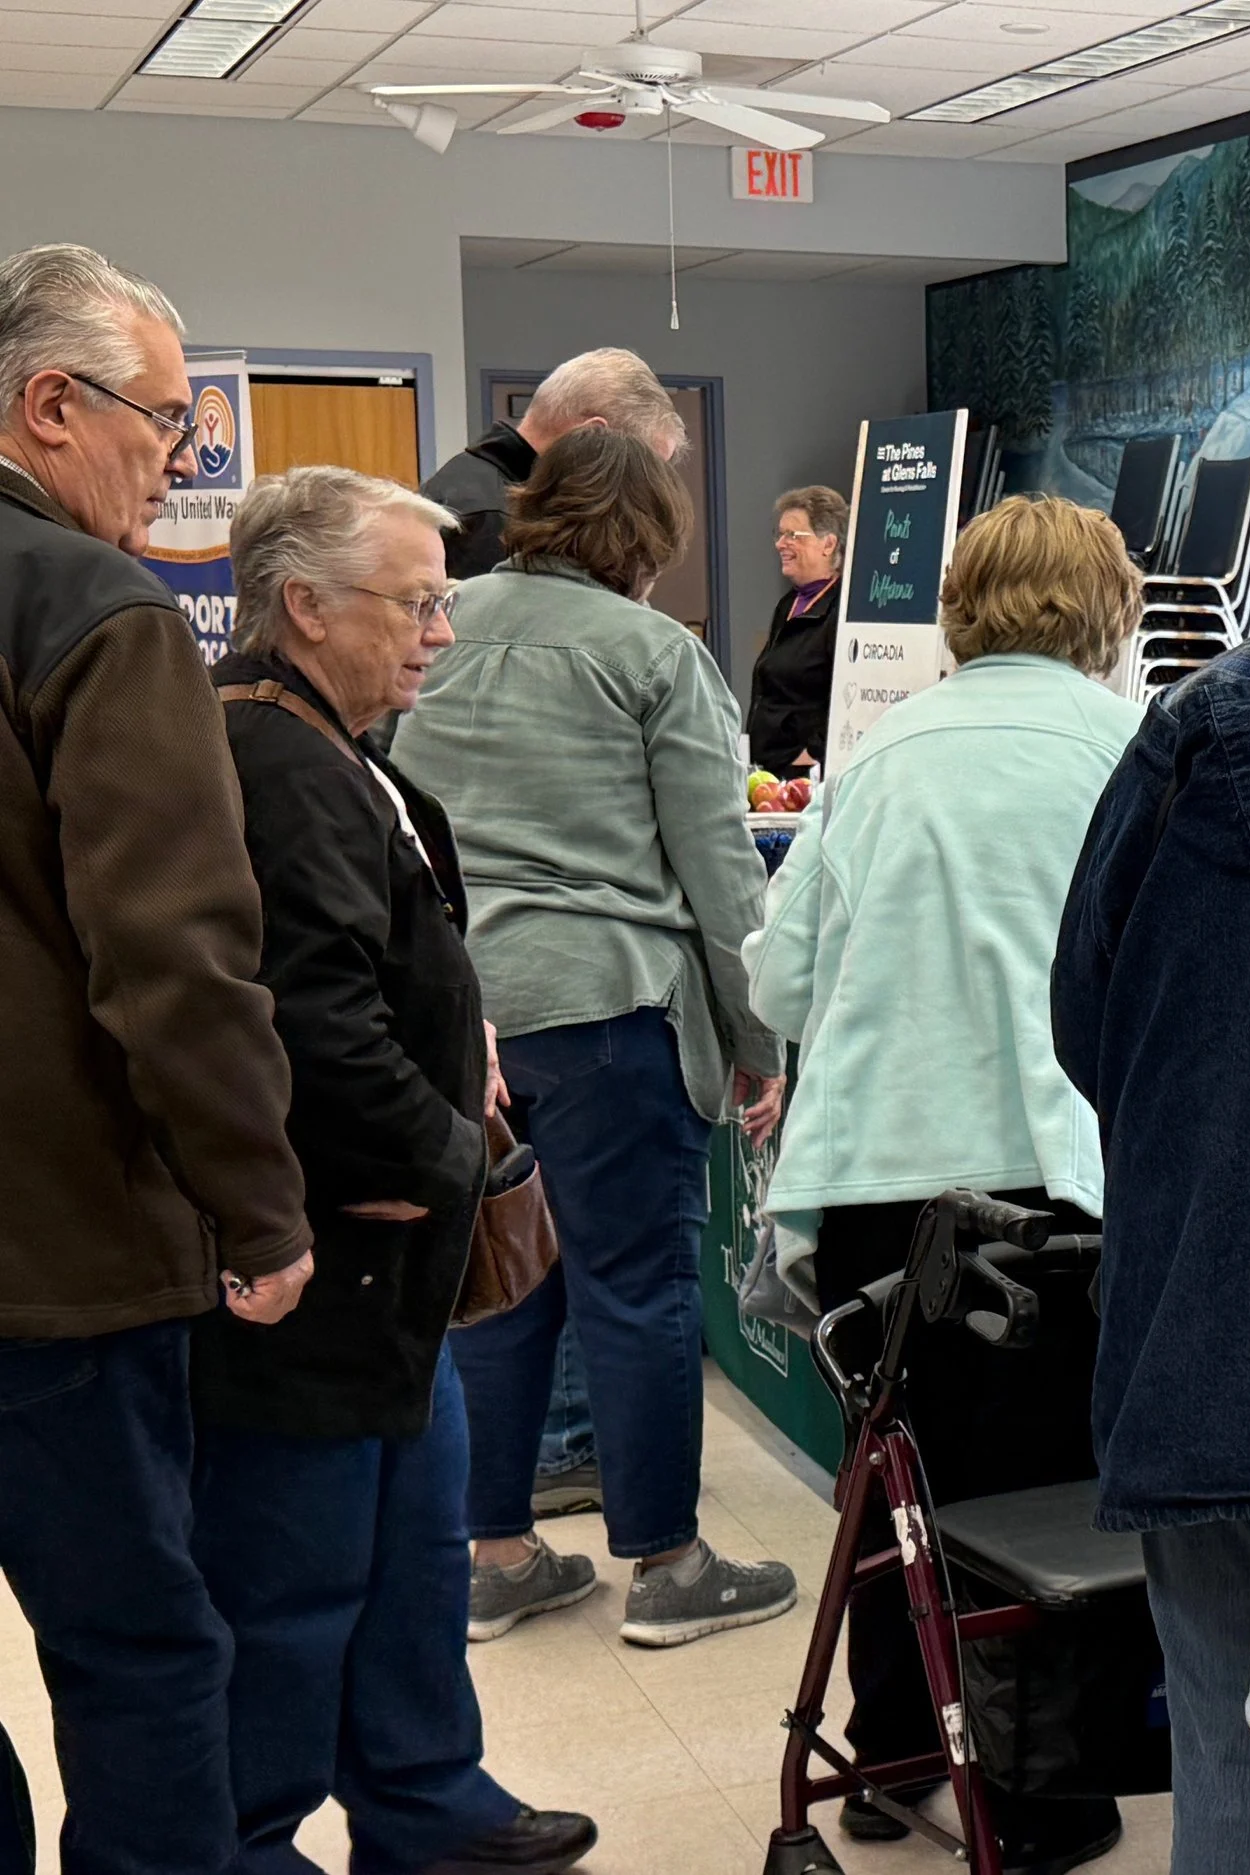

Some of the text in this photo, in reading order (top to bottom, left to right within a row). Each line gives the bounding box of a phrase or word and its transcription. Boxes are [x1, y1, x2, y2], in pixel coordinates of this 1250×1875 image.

[747, 150, 803, 197] EXIT
[885, 442, 925, 461] The Pines
[881, 461, 937, 482] at Glens Falls
[180, 496, 212, 519] United
[214, 496, 237, 519] Wa
[889, 547, 900, 565] of
[869, 569, 915, 608] Difference
[175, 593, 238, 634] PORT
[863, 643, 904, 661] CIRCADIA
[860, 688, 888, 703] WOUND
